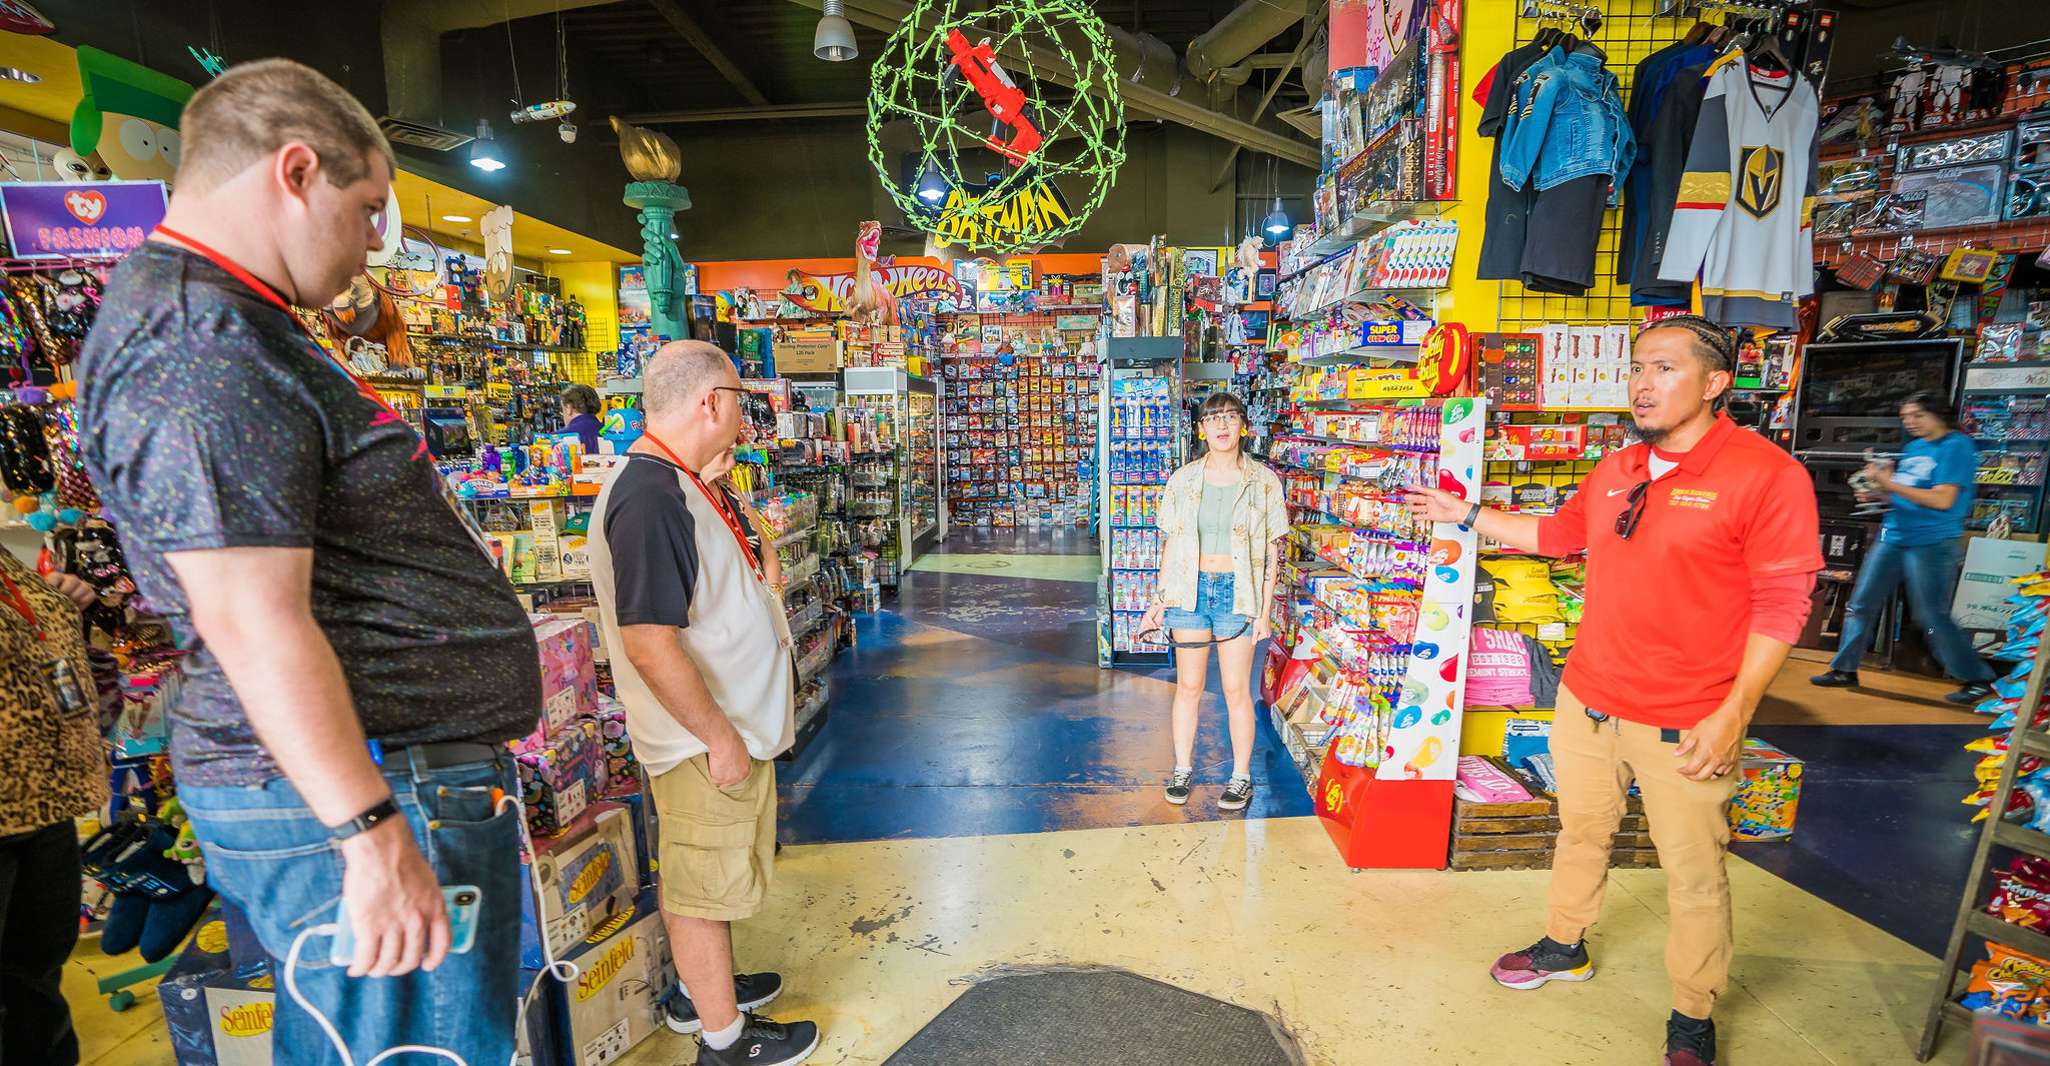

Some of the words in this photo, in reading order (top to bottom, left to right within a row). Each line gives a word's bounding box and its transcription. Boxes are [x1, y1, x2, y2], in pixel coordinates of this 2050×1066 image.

[67, 192, 102, 220] ty
[934, 178, 1071, 254] BATMAN
[37, 226, 145, 250] FASHION
[1369, 325, 1398, 334] SUPER
[1483, 629, 1528, 656] SHAC
[577, 935, 635, 999] Seinfeld
[221, 1003, 273, 1032] Seinfel
